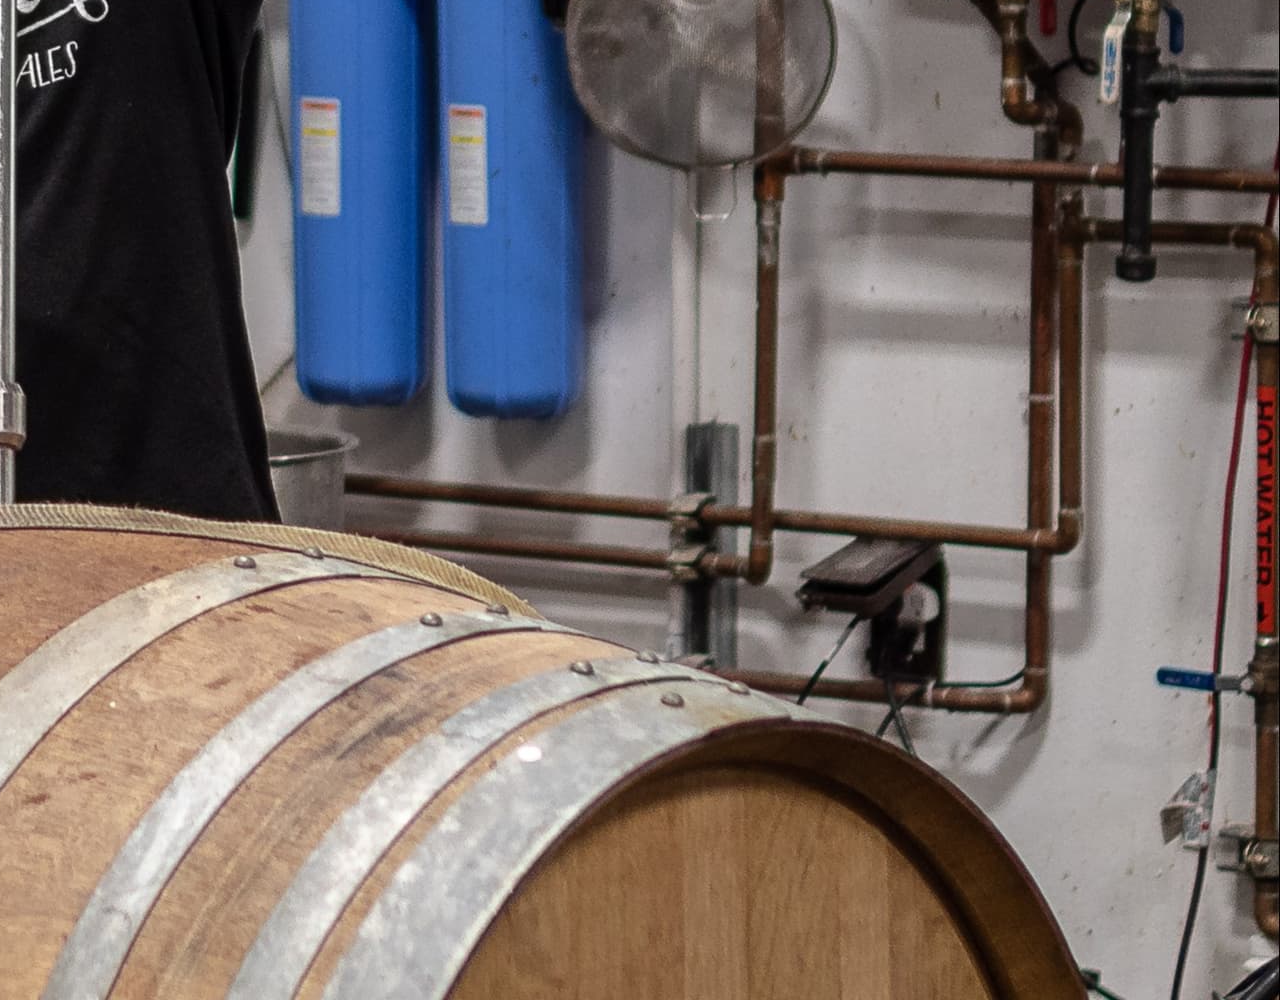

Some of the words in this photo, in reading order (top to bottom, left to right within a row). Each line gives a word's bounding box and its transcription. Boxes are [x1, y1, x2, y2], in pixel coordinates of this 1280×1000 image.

[15, 40, 79, 89] ALES
[1256, 401, 1274, 467] HOT
[1256, 474, 1274, 586] WATER
